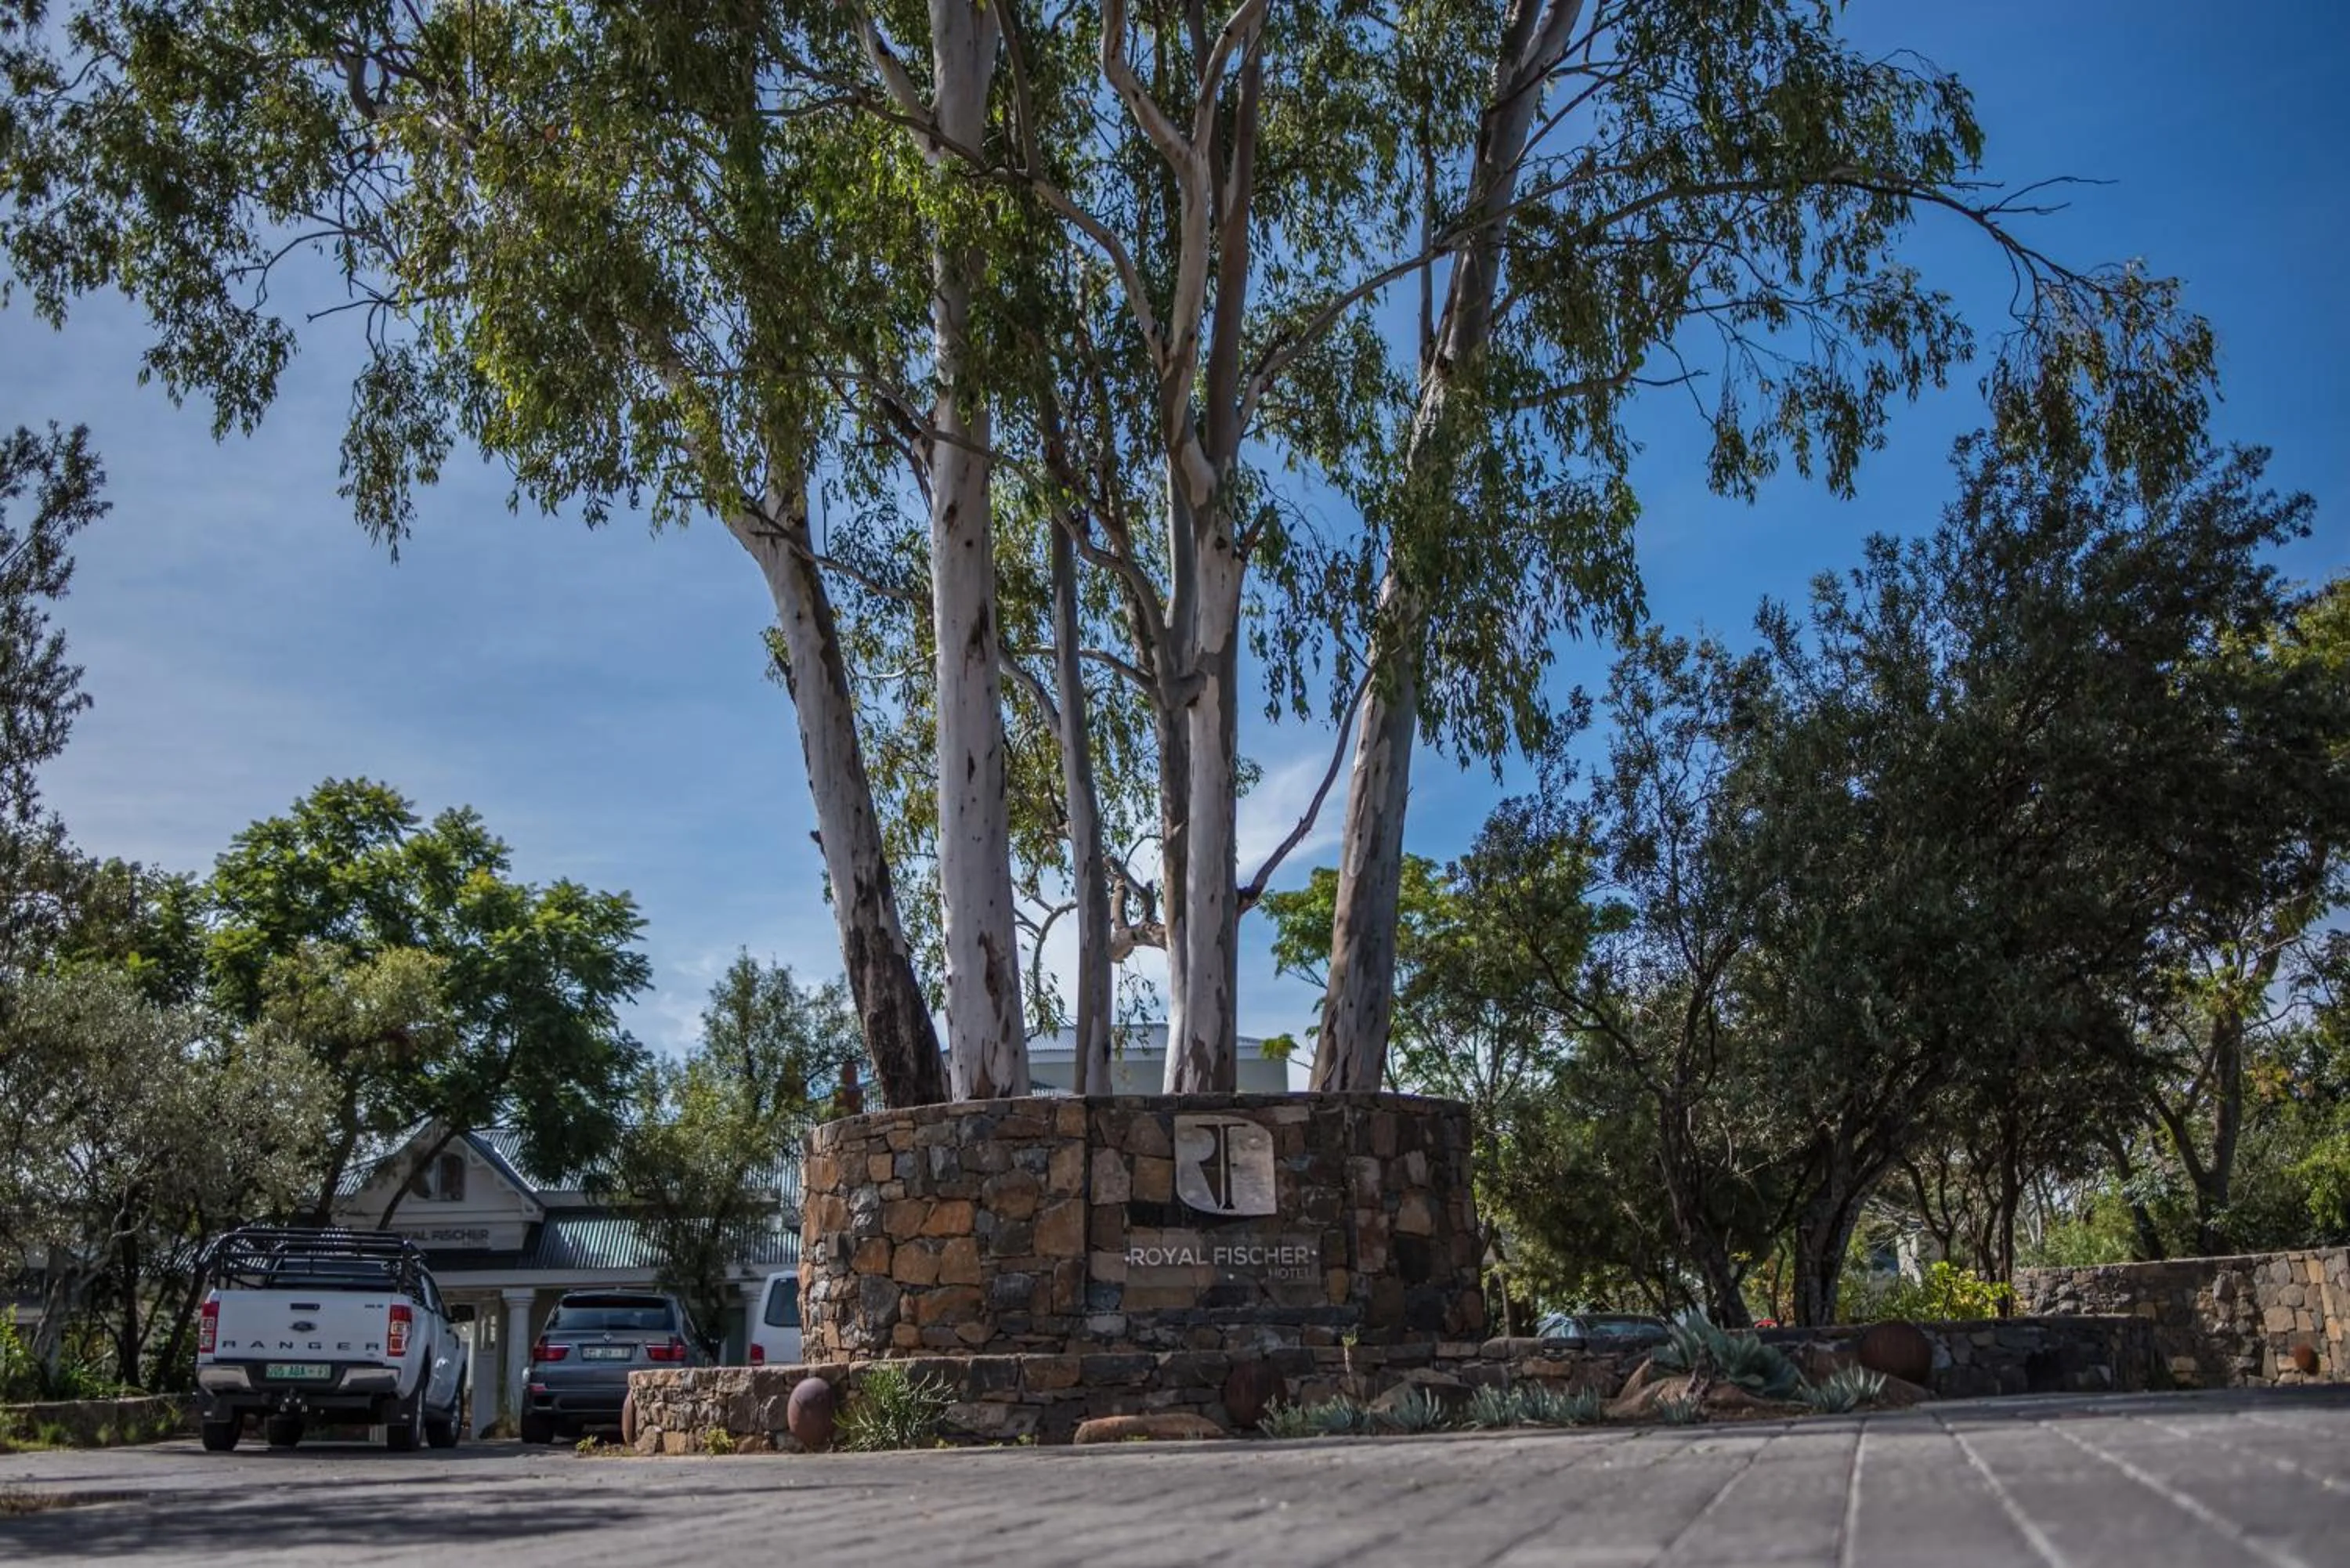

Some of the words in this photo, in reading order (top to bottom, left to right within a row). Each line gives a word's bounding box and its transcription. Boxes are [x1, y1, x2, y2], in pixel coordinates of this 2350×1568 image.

[432, 1229, 490, 1241] FISCHER
[1130, 1247, 1208, 1266] ROYAL
[1215, 1246, 1309, 1265] FISCHER
[1268, 1267, 1311, 1280] HOTEL
[222, 1340, 380, 1351] RANGER
